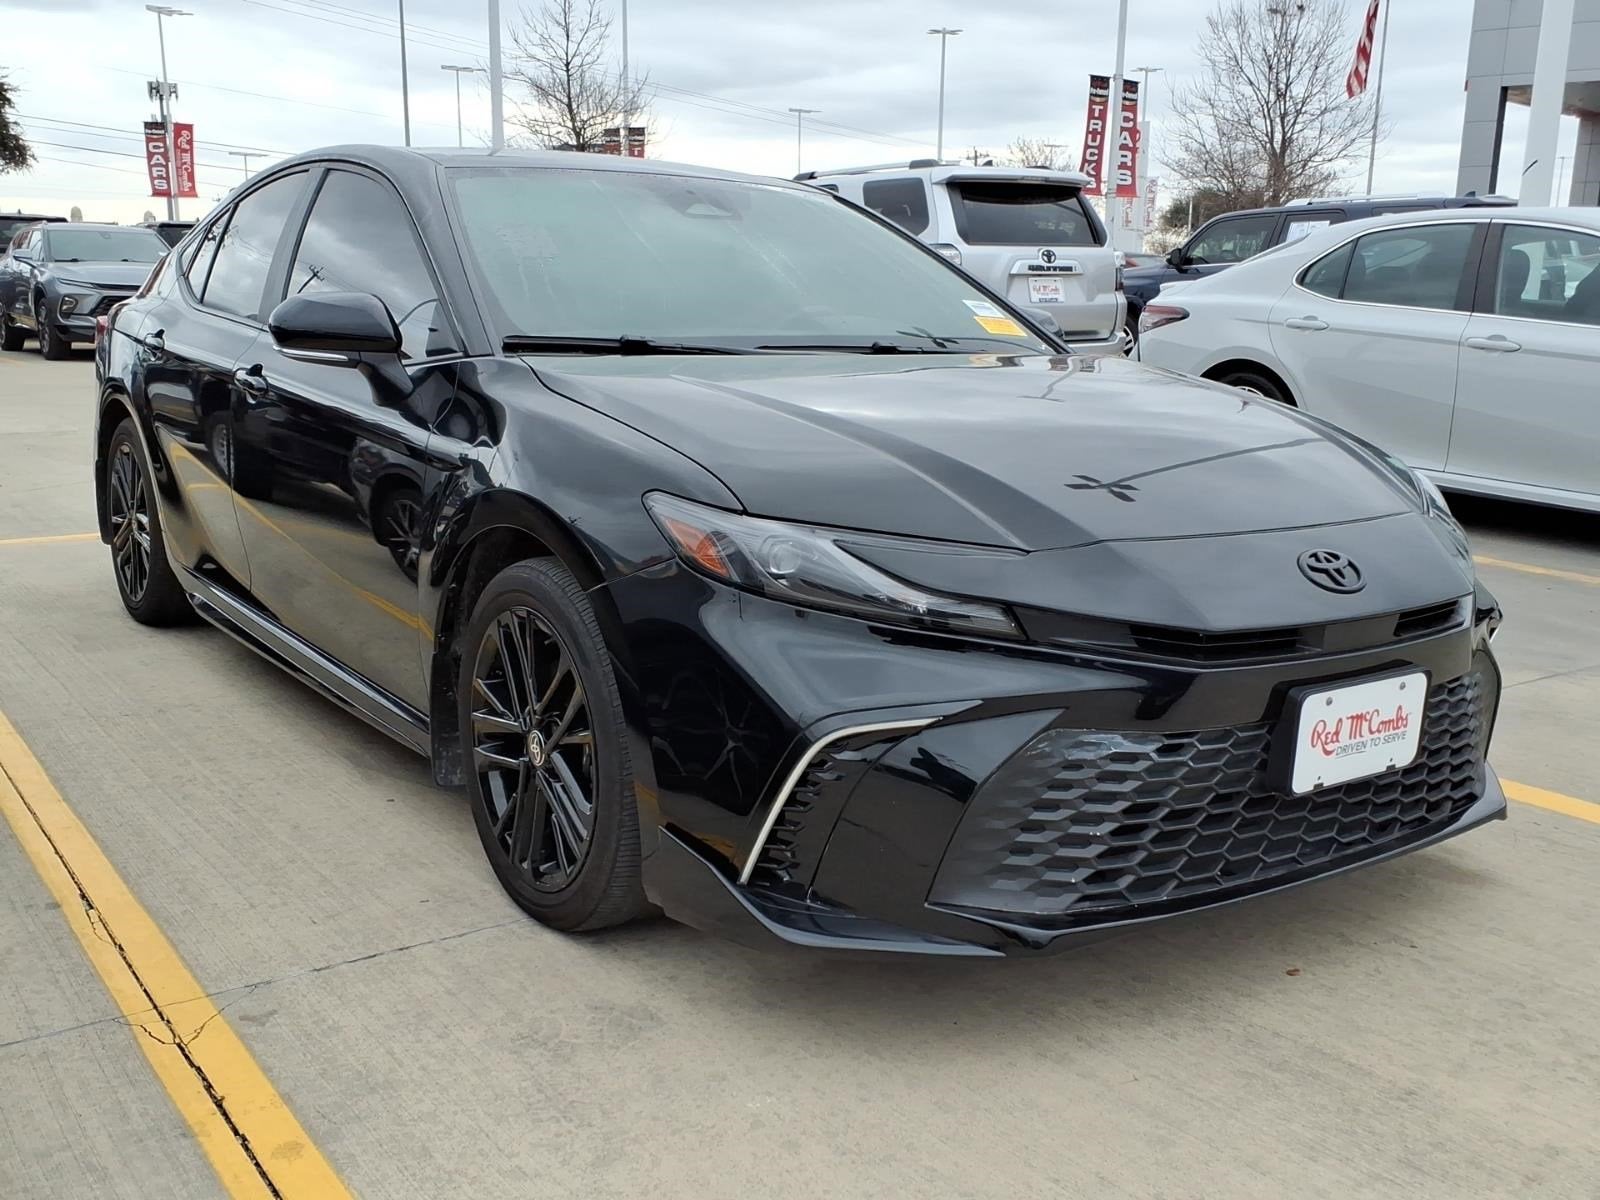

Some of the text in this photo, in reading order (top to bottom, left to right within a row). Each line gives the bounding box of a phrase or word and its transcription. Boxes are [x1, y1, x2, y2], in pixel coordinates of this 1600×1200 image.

[177, 130, 191, 150] Red
[1083, 104, 1104, 188] TRUCKS
[1117, 111, 1134, 186] CARS
[148, 141, 168, 190] CARS
[1310, 705, 1409, 756] Red McCombs
[1335, 731, 1407, 756] DRIVEN TO SERVE
